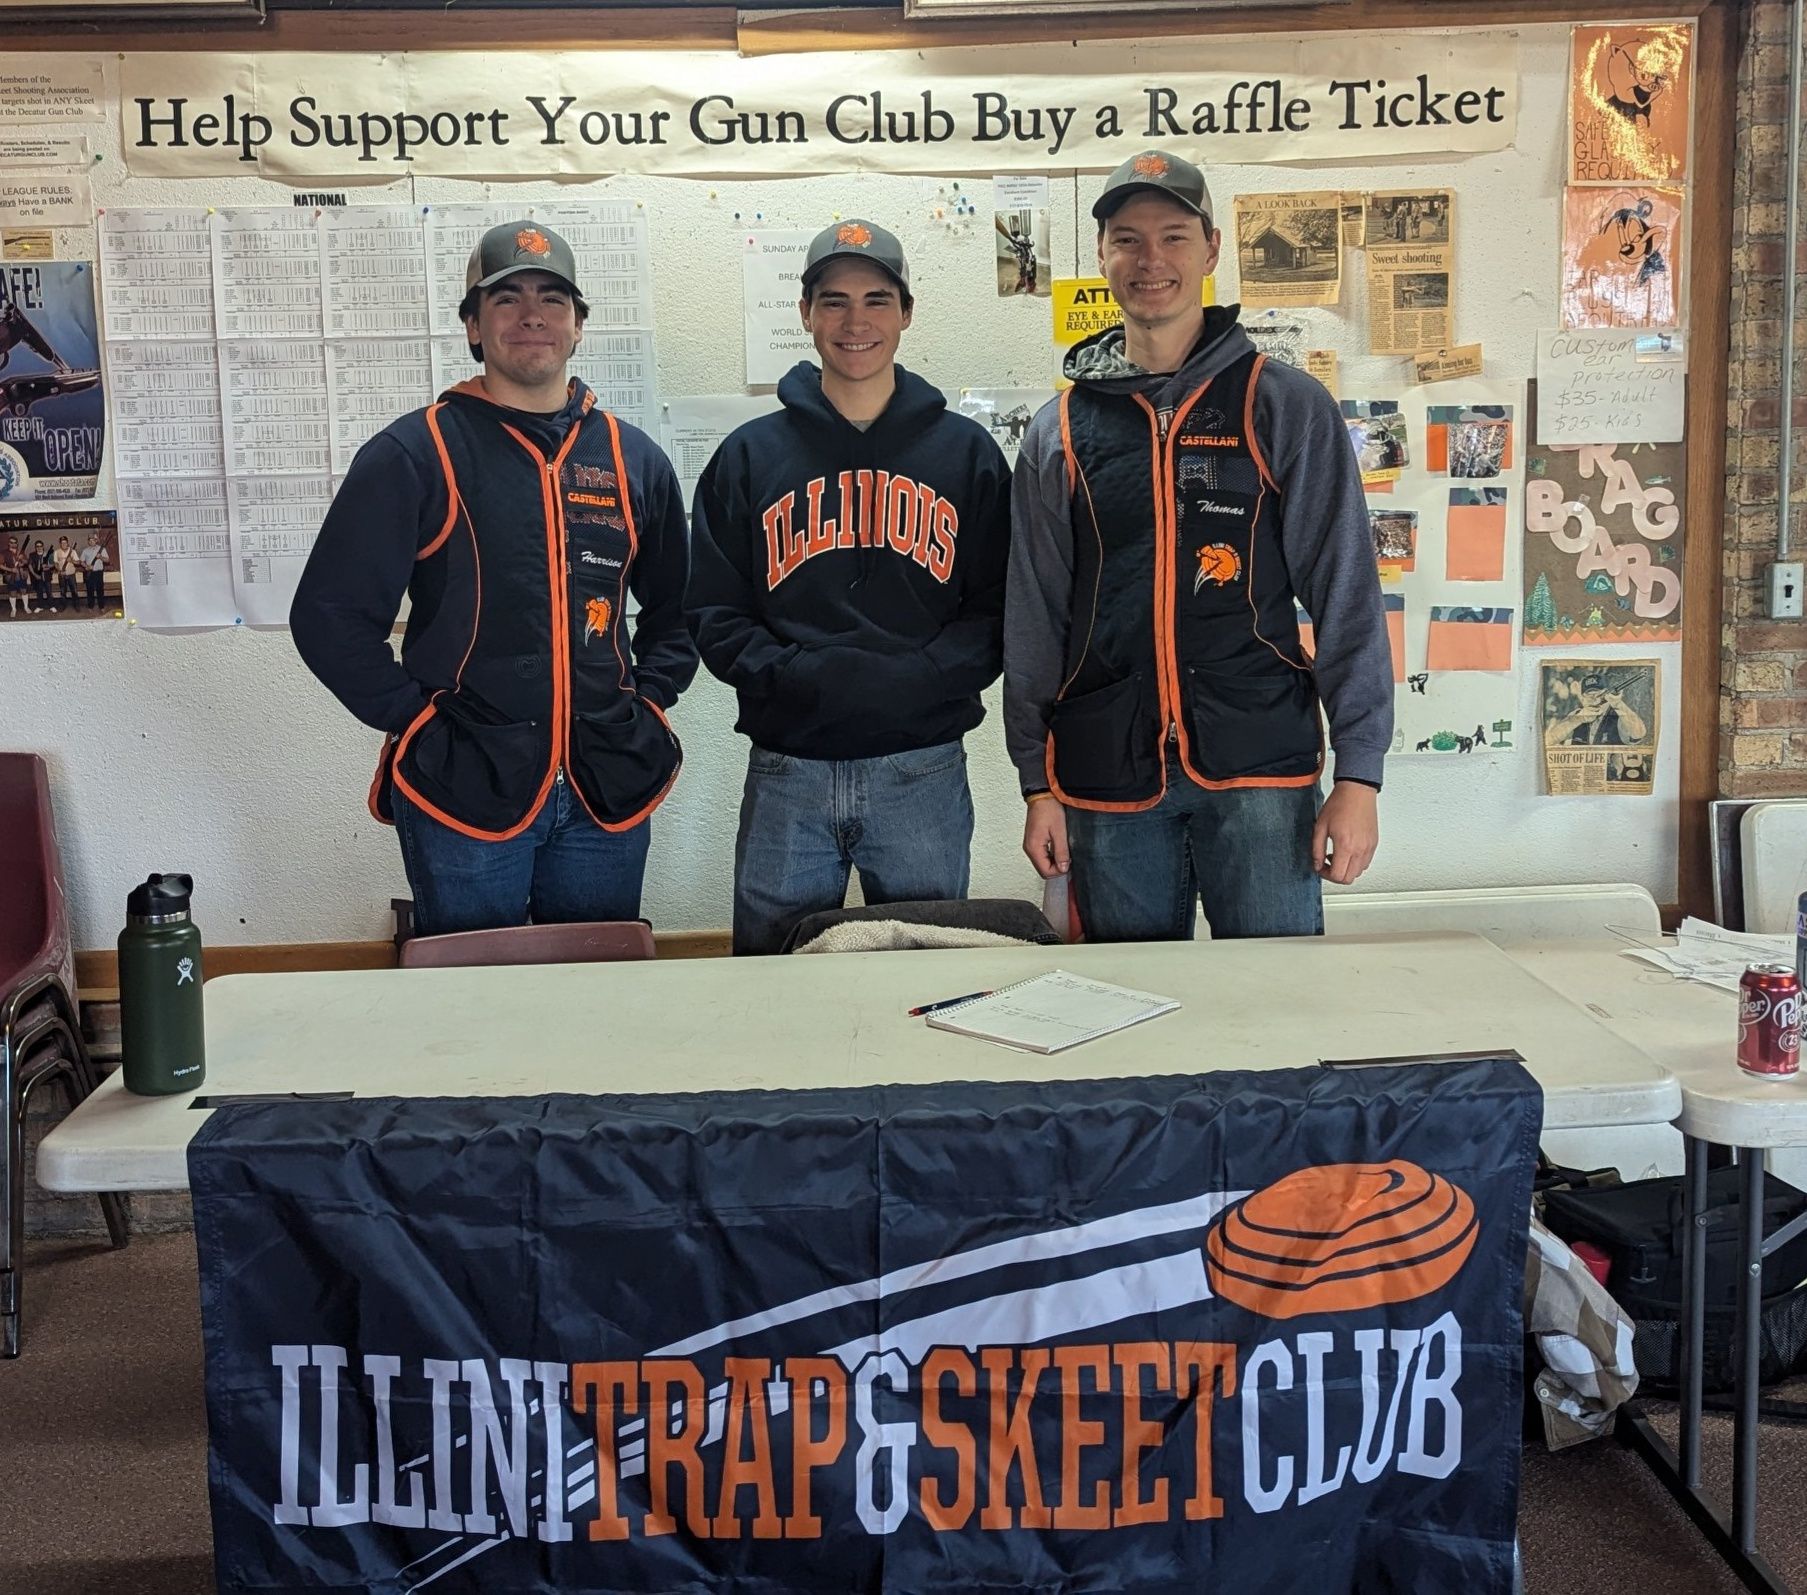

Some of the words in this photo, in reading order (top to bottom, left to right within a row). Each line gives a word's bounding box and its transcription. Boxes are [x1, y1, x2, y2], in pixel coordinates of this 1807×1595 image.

[13, 86, 46, 96] Shooting
[48, 86, 90, 94] Association
[2, 98, 26, 106] targets
[74, 96, 95, 104] Skeet
[48, 107, 64, 115] Gun
[65, 107, 84, 115] Club
[135, 95, 272, 161] Help
[290, 97, 509, 161] Support
[526, 96, 671, 146] Your
[689, 96, 809, 144] Gun
[825, 90, 955, 143] Club
[972, 91, 1076, 155] Buy
[1095, 104, 1124, 138] a
[1143, 80, 1312, 138] Raffle
[1328, 74, 1506, 130] Ticket
[2, 187, 38, 196] LEAGUE
[18, 198, 39, 206] Have
[49, 197, 74, 205] BANK
[294, 193, 348, 207] NATIONAL
[1266, 199, 1291, 210] LOOK
[1292, 198, 1318, 208] BACK
[762, 245, 797, 253] SUNDAY
[1372, 252, 1399, 265] Sweet
[1402, 251, 1443, 266] shooting
[1073, 288, 1112, 304] ATT
[758, 300, 797, 308] ALL-STAR
[1067, 311, 1088, 321] EYE
[1091, 311, 1099, 319] &
[1103, 310, 1124, 319] EAR
[771, 328, 803, 336] WORLD
[769, 342, 816, 350] CHAMPION
[1550, 338, 1636, 359] Custom
[1583, 353, 1622, 367] ear
[1571, 364, 1675, 388] protection
[1609, 387, 1658, 404] Adult
[1605, 412, 1642, 429] Kids
[3, 418, 31, 441] KEEP
[32, 417, 44, 441] IT
[1179, 435, 1239, 447] CASTELLANI
[44, 427, 102, 471] OPEN!
[1196, 500, 1245, 516] Thomas
[36, 518, 59, 527] GUN
[68, 517, 99, 526] CLUB
[762, 469, 959, 592] ILLINOIS
[1526, 479, 1681, 619] BOARD
[581, 551, 623, 568] Harrison
[1548, 752, 1572, 764] SHOT
[1573, 752, 1584, 764] OF
[1585, 752, 1606, 763] LIFE
[272, 1344, 574, 1542] ILLINI
[572, 1357, 848, 1542] TRAP
[855, 1351, 917, 1535] &
[920, 1342, 1238, 1532] SKEET
[1242, 1311, 1463, 1514] CLUB
